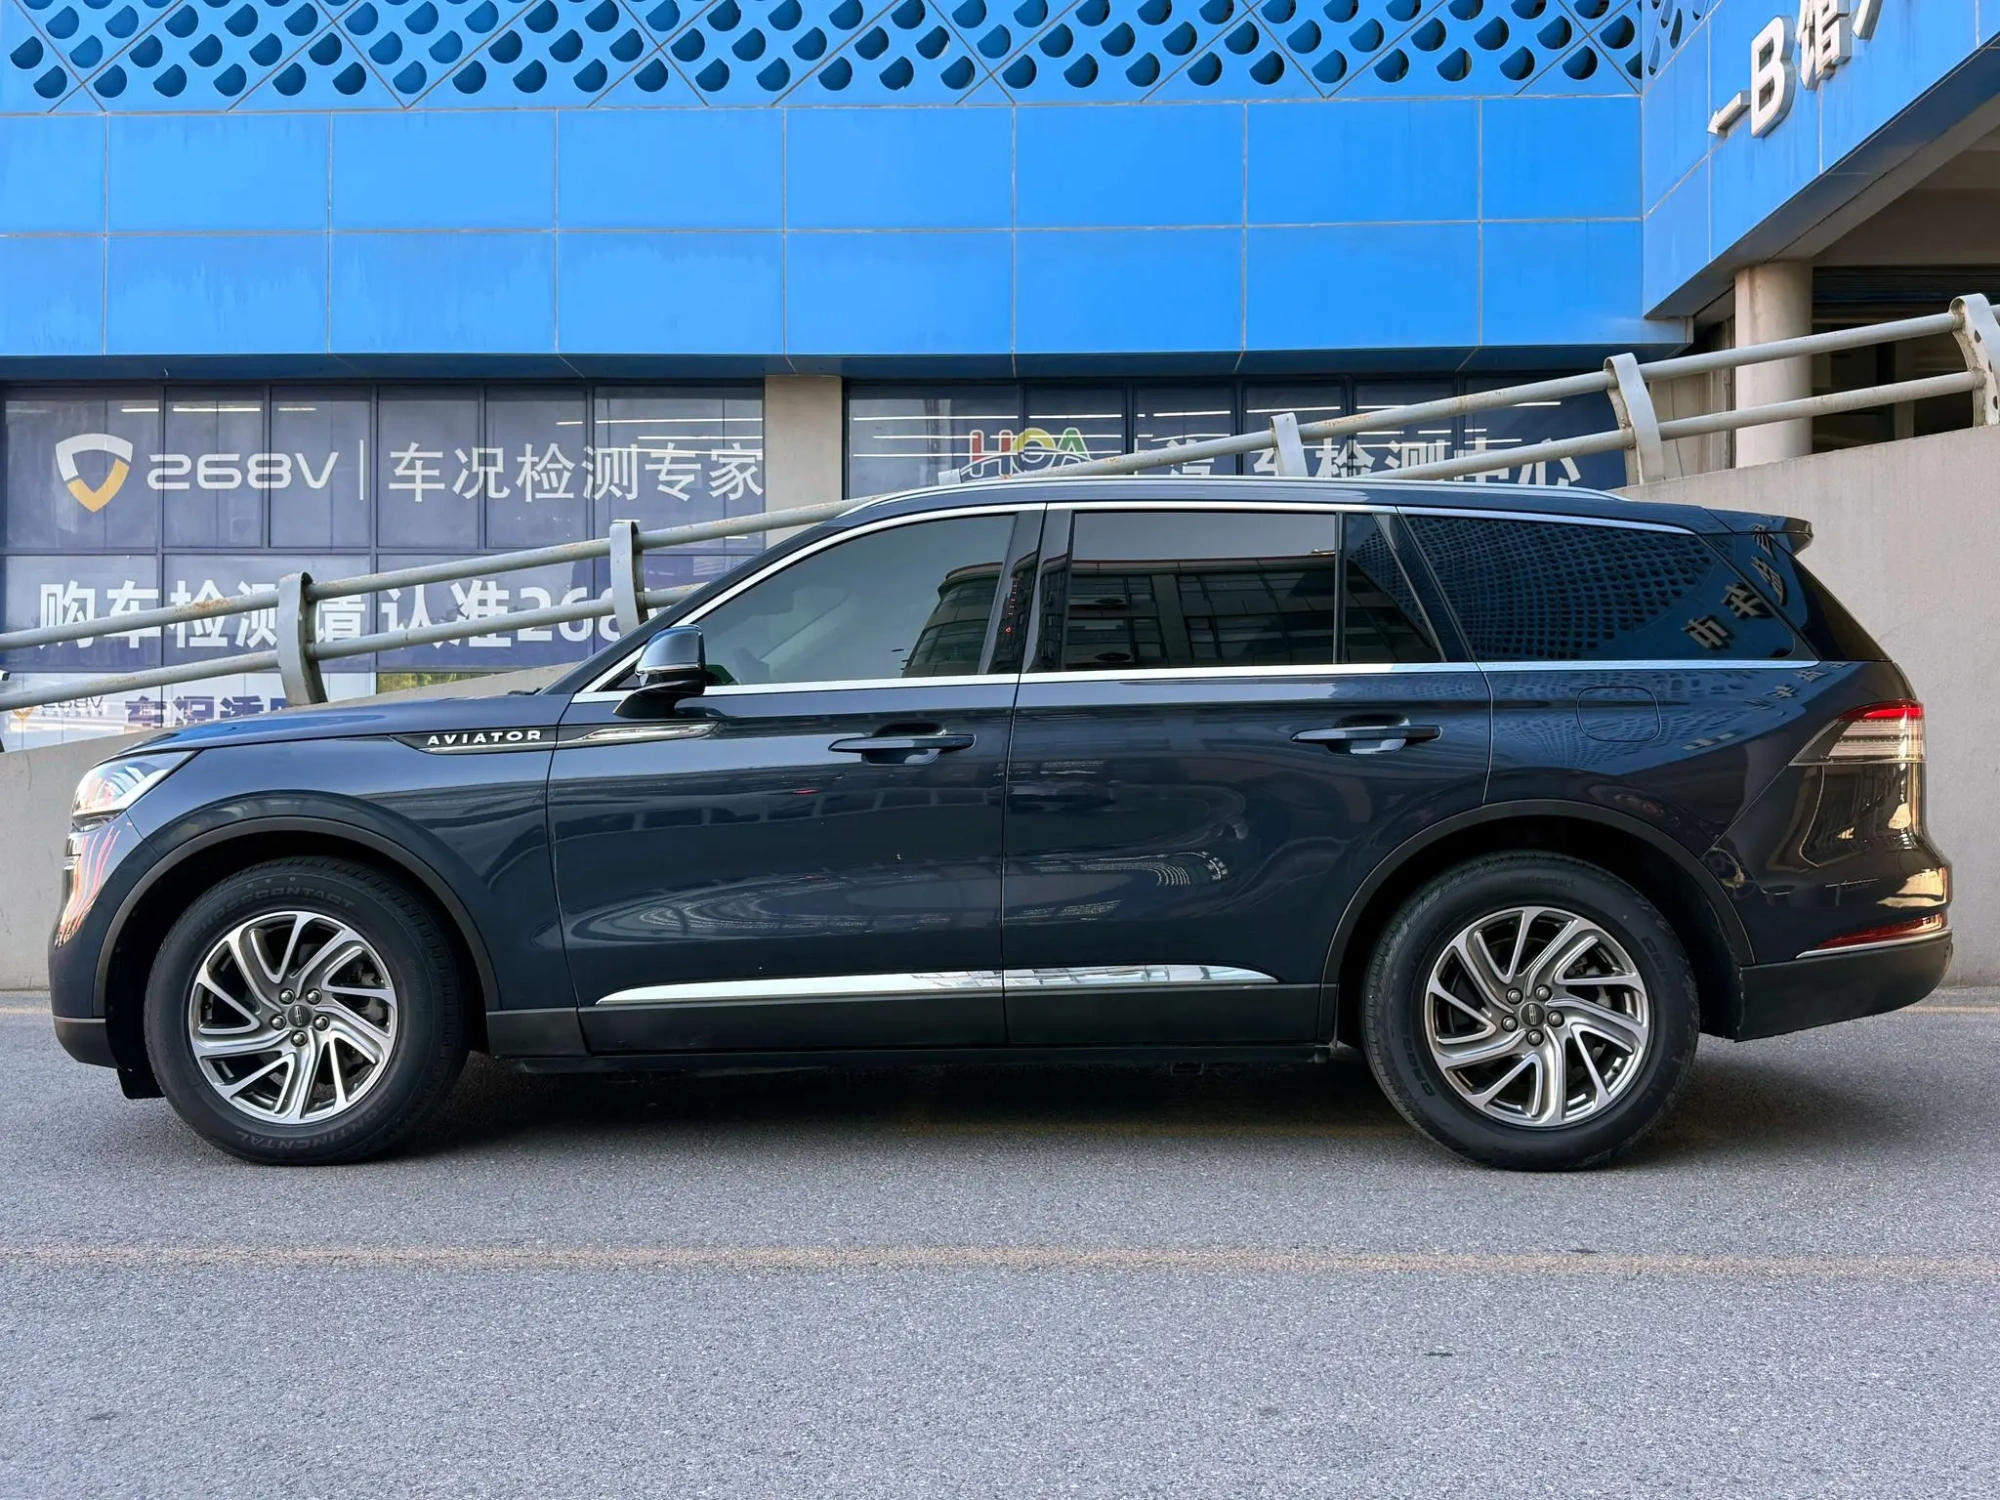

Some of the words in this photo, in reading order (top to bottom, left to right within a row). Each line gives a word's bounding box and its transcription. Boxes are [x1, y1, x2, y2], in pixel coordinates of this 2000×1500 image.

[146, 451, 339, 490] 268V
[388, 442, 763, 502] 车况检测专家
[426, 730, 541, 746] AVIATOR
